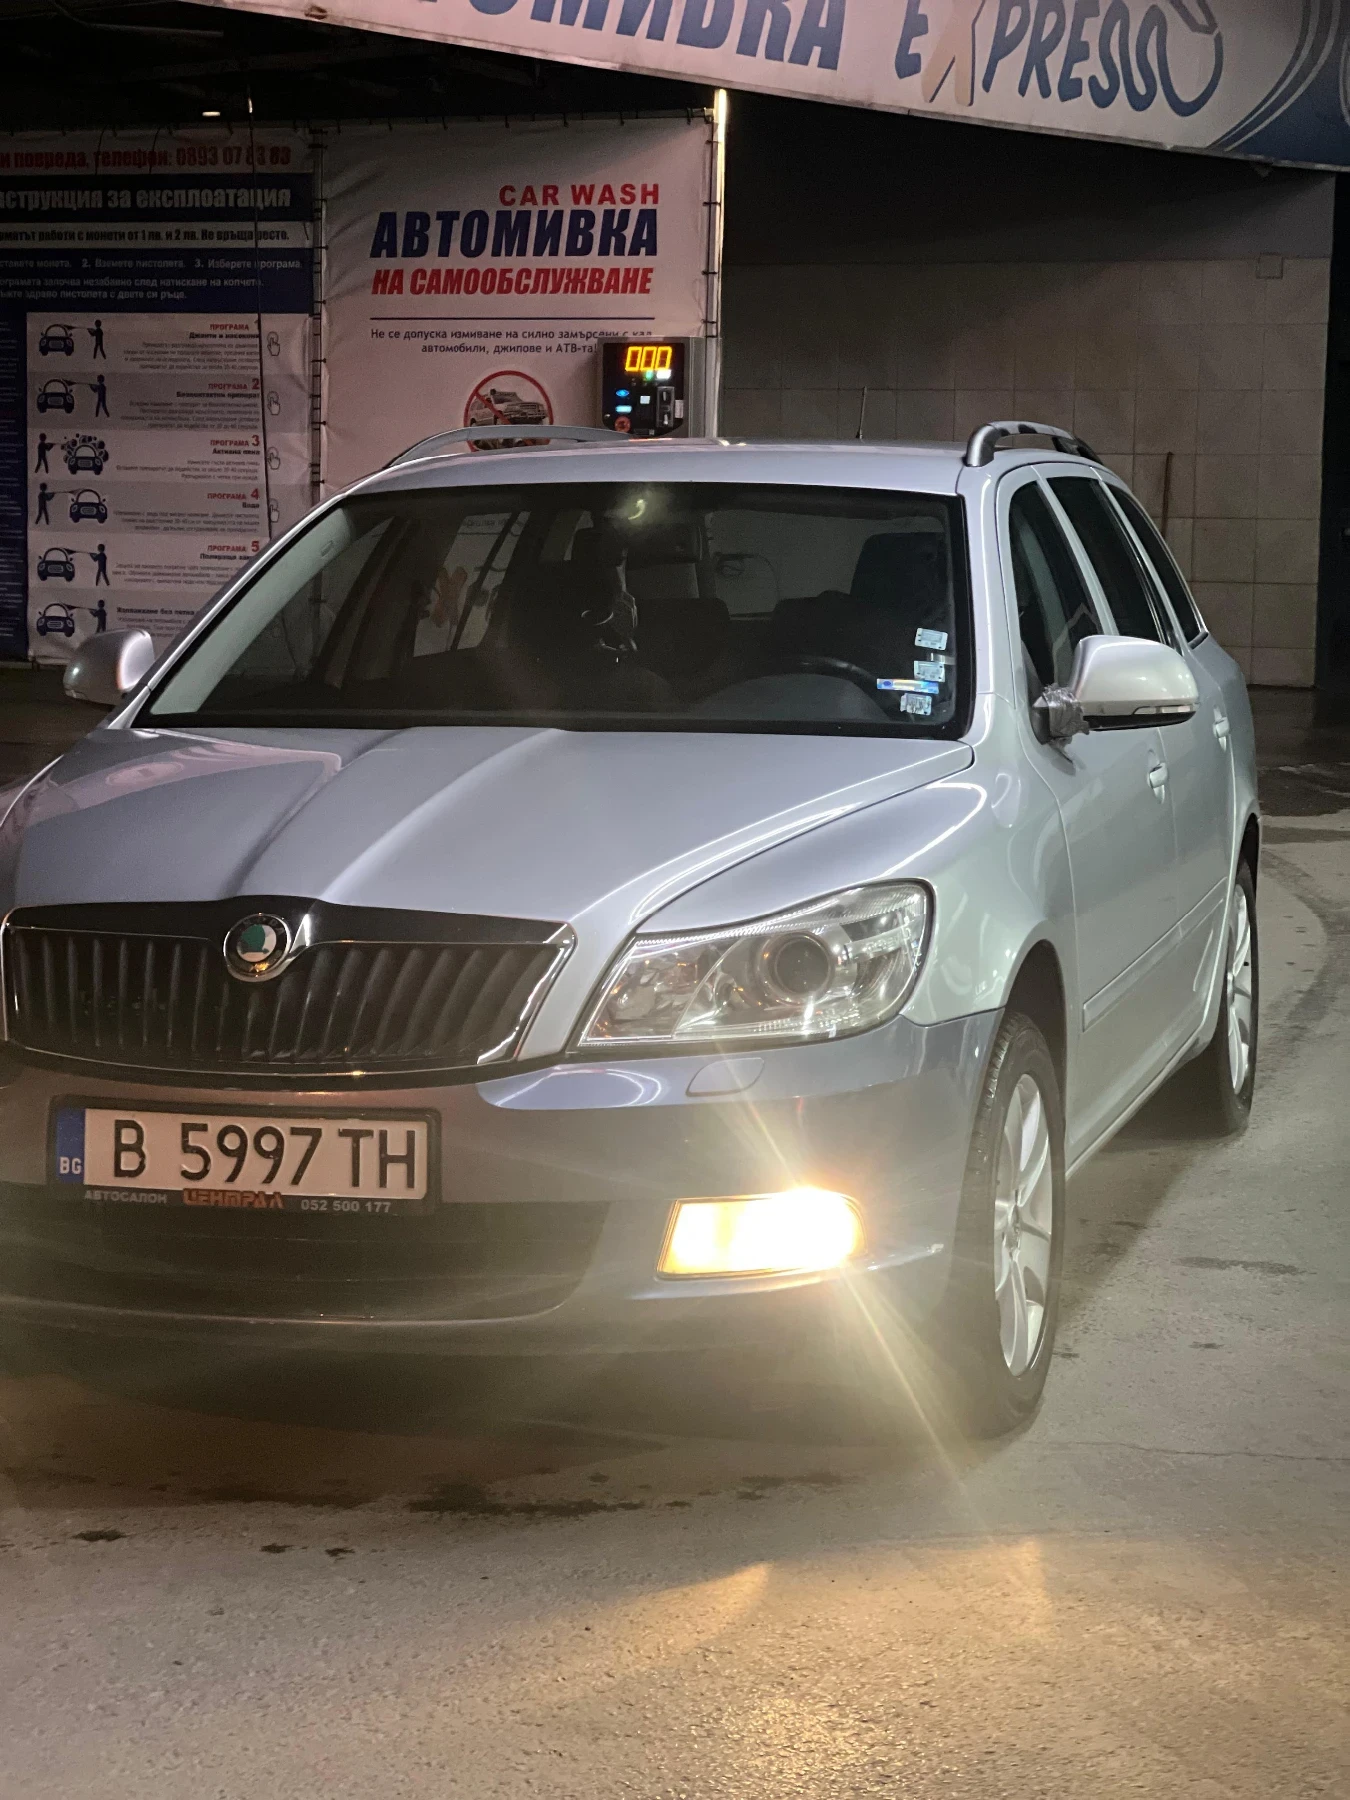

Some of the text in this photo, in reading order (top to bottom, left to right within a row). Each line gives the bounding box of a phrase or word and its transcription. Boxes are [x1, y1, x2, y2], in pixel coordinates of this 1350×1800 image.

[222, 146, 242, 165] 07
[107, 190, 132, 209] за
[136, 188, 291, 211] експлоатация
[499, 184, 660, 207] CAR WASH
[175, 229, 181, 240] 2
[369, 208, 658, 258] АВТОМИВКА
[371, 267, 655, 295] НА САМООБСЛУЖВАНЕ
[210, 323, 249, 331] ПРОГРАМА
[371, 329, 385, 340] Не
[388, 331, 400, 340] се
[403, 331, 447, 344] допуска
[450, 331, 502, 340] измиване
[506, 331, 518, 340] на
[522, 330, 555, 340] силно
[558, 330, 619, 342] замърсени
[421, 341, 597, 356] автомобили, джипове и АТВ-та!
[625, 346, 672, 372] 000
[208, 377, 260, 391] ПРОГРАМА 2
[211, 434, 260, 447] ПРОГРАМА 3
[251, 487, 260, 500] 4
[207, 541, 260, 552] ПРОГРАМА 5
[114, 1119, 416, 1190] B 5997 TH
[59, 1156, 83, 1175] BG
[84, 1189, 168, 1205] АВТОСАЛОН
[300, 1199, 328, 1212] 052
[332, 1200, 361, 1213] 500
[365, 1201, 392, 1214] 177
